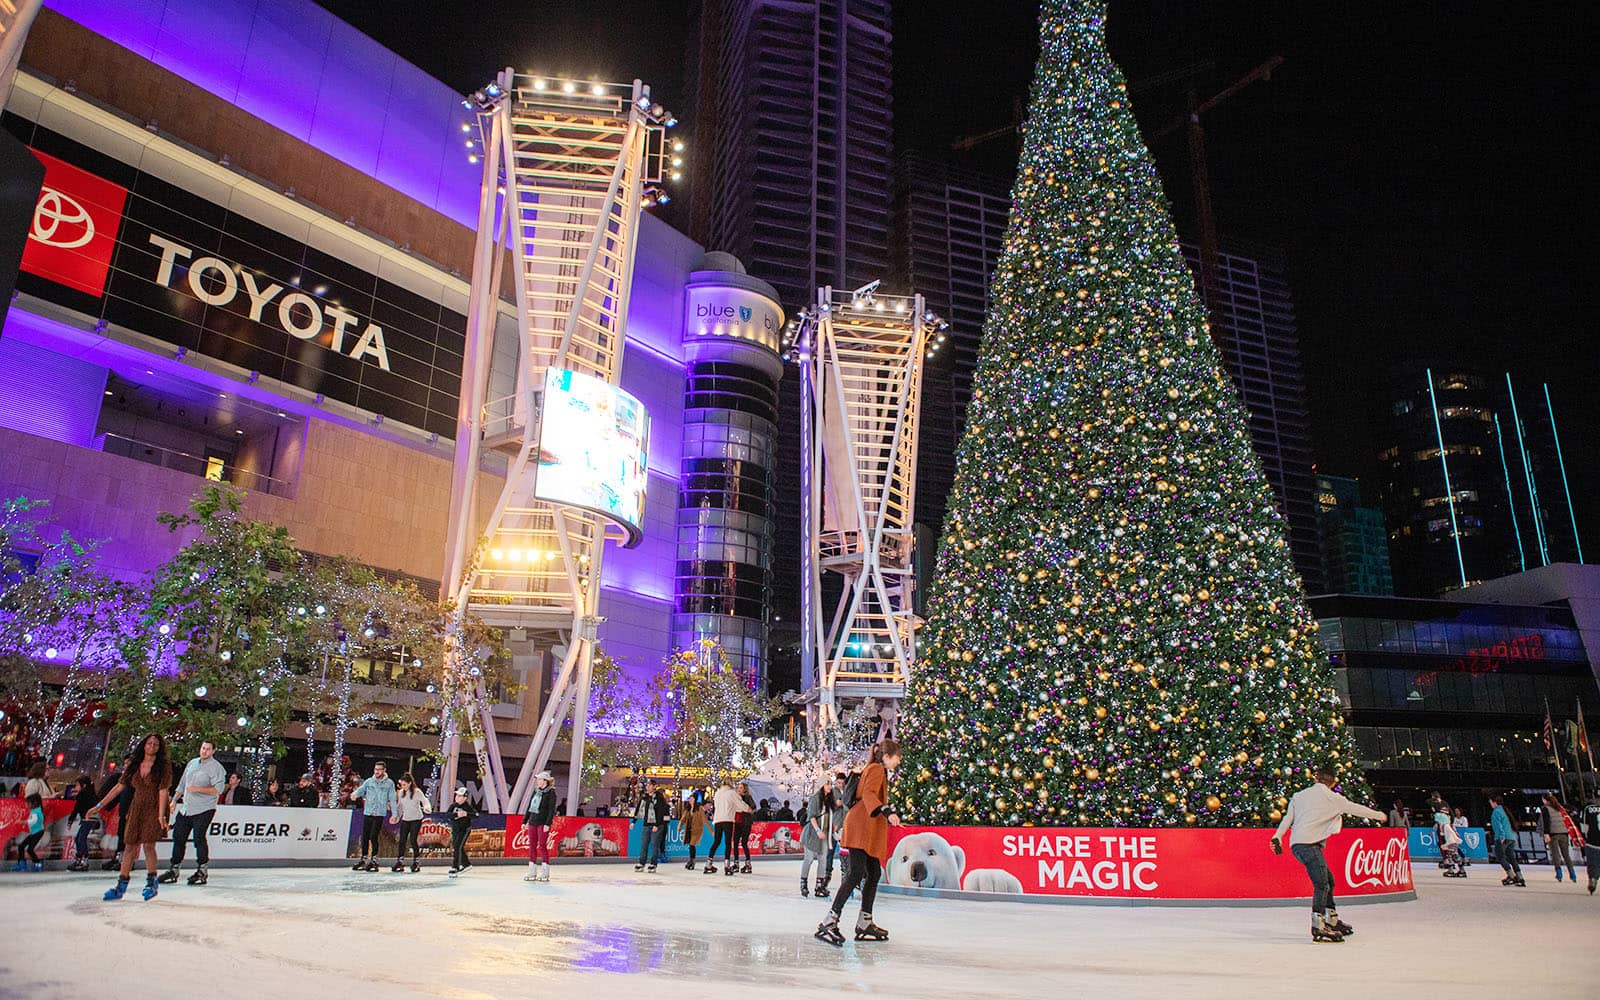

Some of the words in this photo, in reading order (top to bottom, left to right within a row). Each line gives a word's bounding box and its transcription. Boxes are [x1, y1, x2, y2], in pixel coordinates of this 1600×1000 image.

[149, 232, 391, 371] TOYOTA
[697, 303, 735, 317] blue
[209, 823, 239, 836] BIG
[244, 823, 290, 837] BEAR
[1003, 835, 1092, 857] SHARE
[1100, 837, 1157, 859] THE
[1038, 861, 1158, 891] MAGIC
